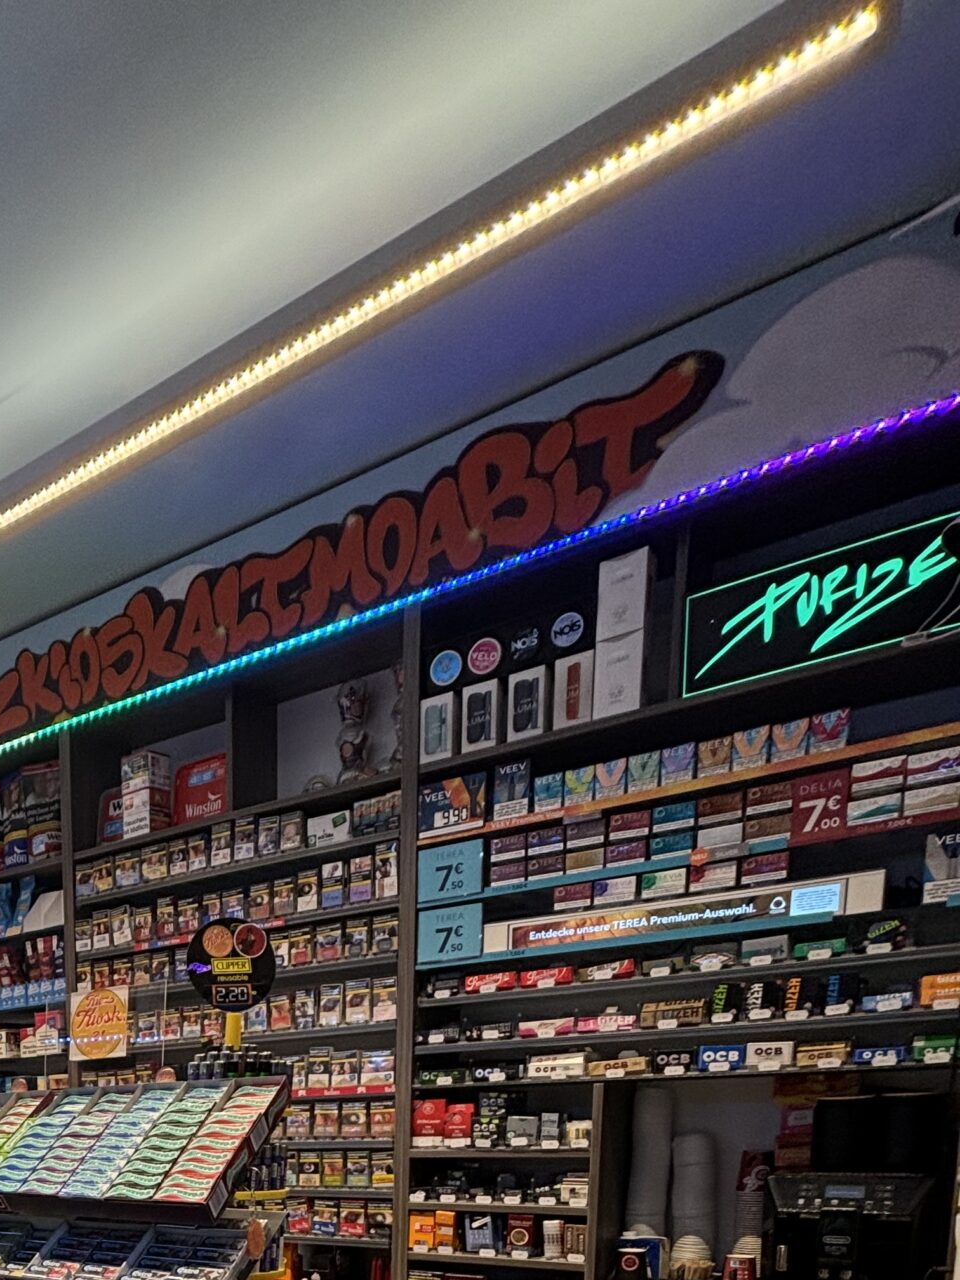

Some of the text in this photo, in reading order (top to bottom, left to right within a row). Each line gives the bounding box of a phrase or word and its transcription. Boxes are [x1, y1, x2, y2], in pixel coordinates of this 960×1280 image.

[499, 761, 527, 775] VEEV
[799, 780, 842, 796] DELIA
[424, 790, 452, 803] VEEV
[185, 798, 223, 819] Winston
[529, 903, 758, 941] Entdecke unsere TEREA Premium-Auswahl.
[215, 960, 248, 971] CLIPPER
[217, 974, 249, 982] reusable
[702, 1050, 739, 1063] OCB
[755, 1046, 783, 1057] OCB
[604, 1060, 628, 1071] OCB
[656, 1053, 691, 1067] OCB
